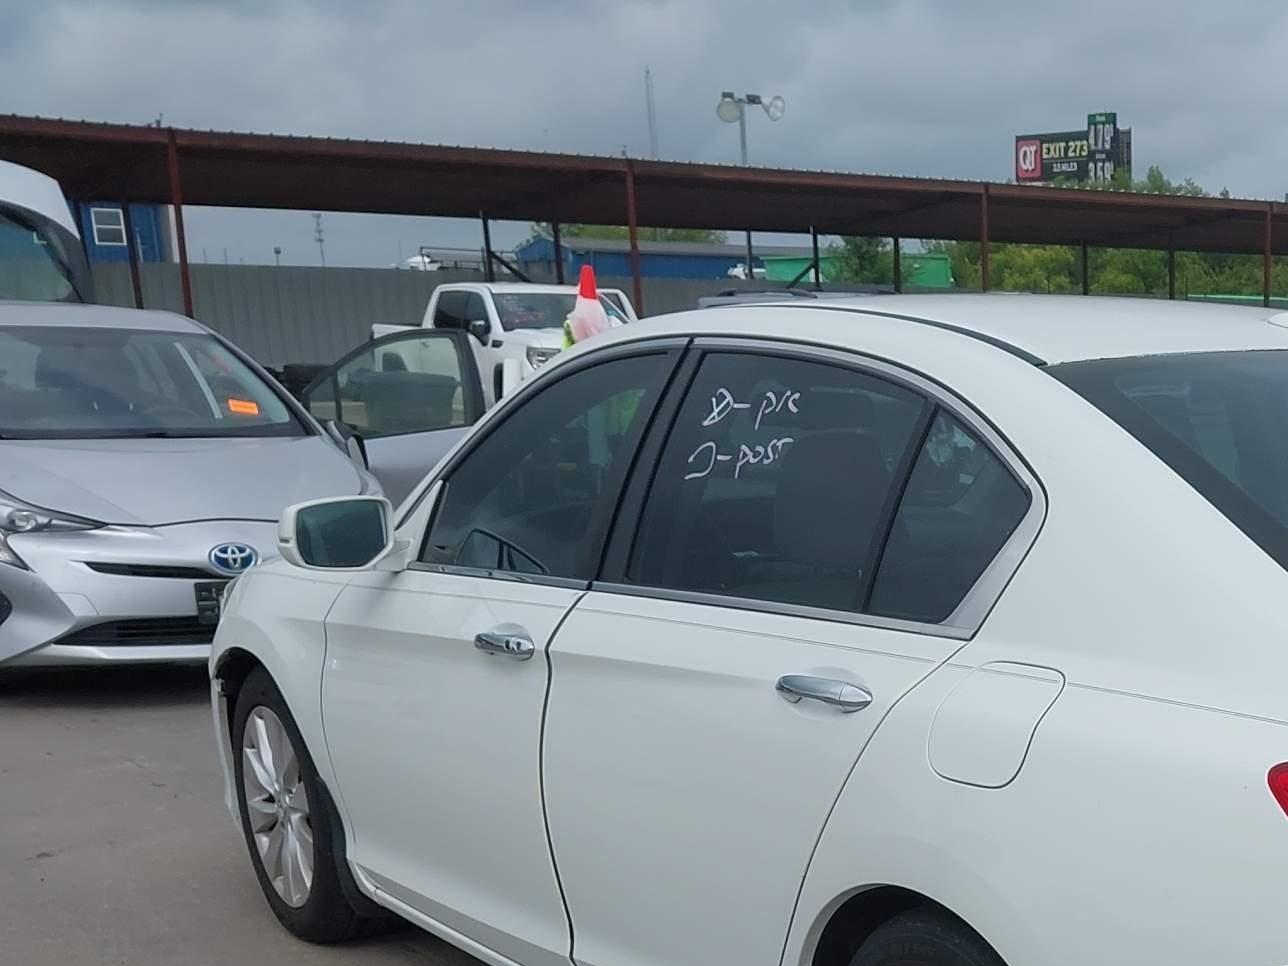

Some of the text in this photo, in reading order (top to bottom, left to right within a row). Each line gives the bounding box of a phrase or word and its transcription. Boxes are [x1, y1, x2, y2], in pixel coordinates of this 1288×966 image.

[1020, 145, 1037, 171] QT
[1042, 140, 1088, 158] EXIT 273
